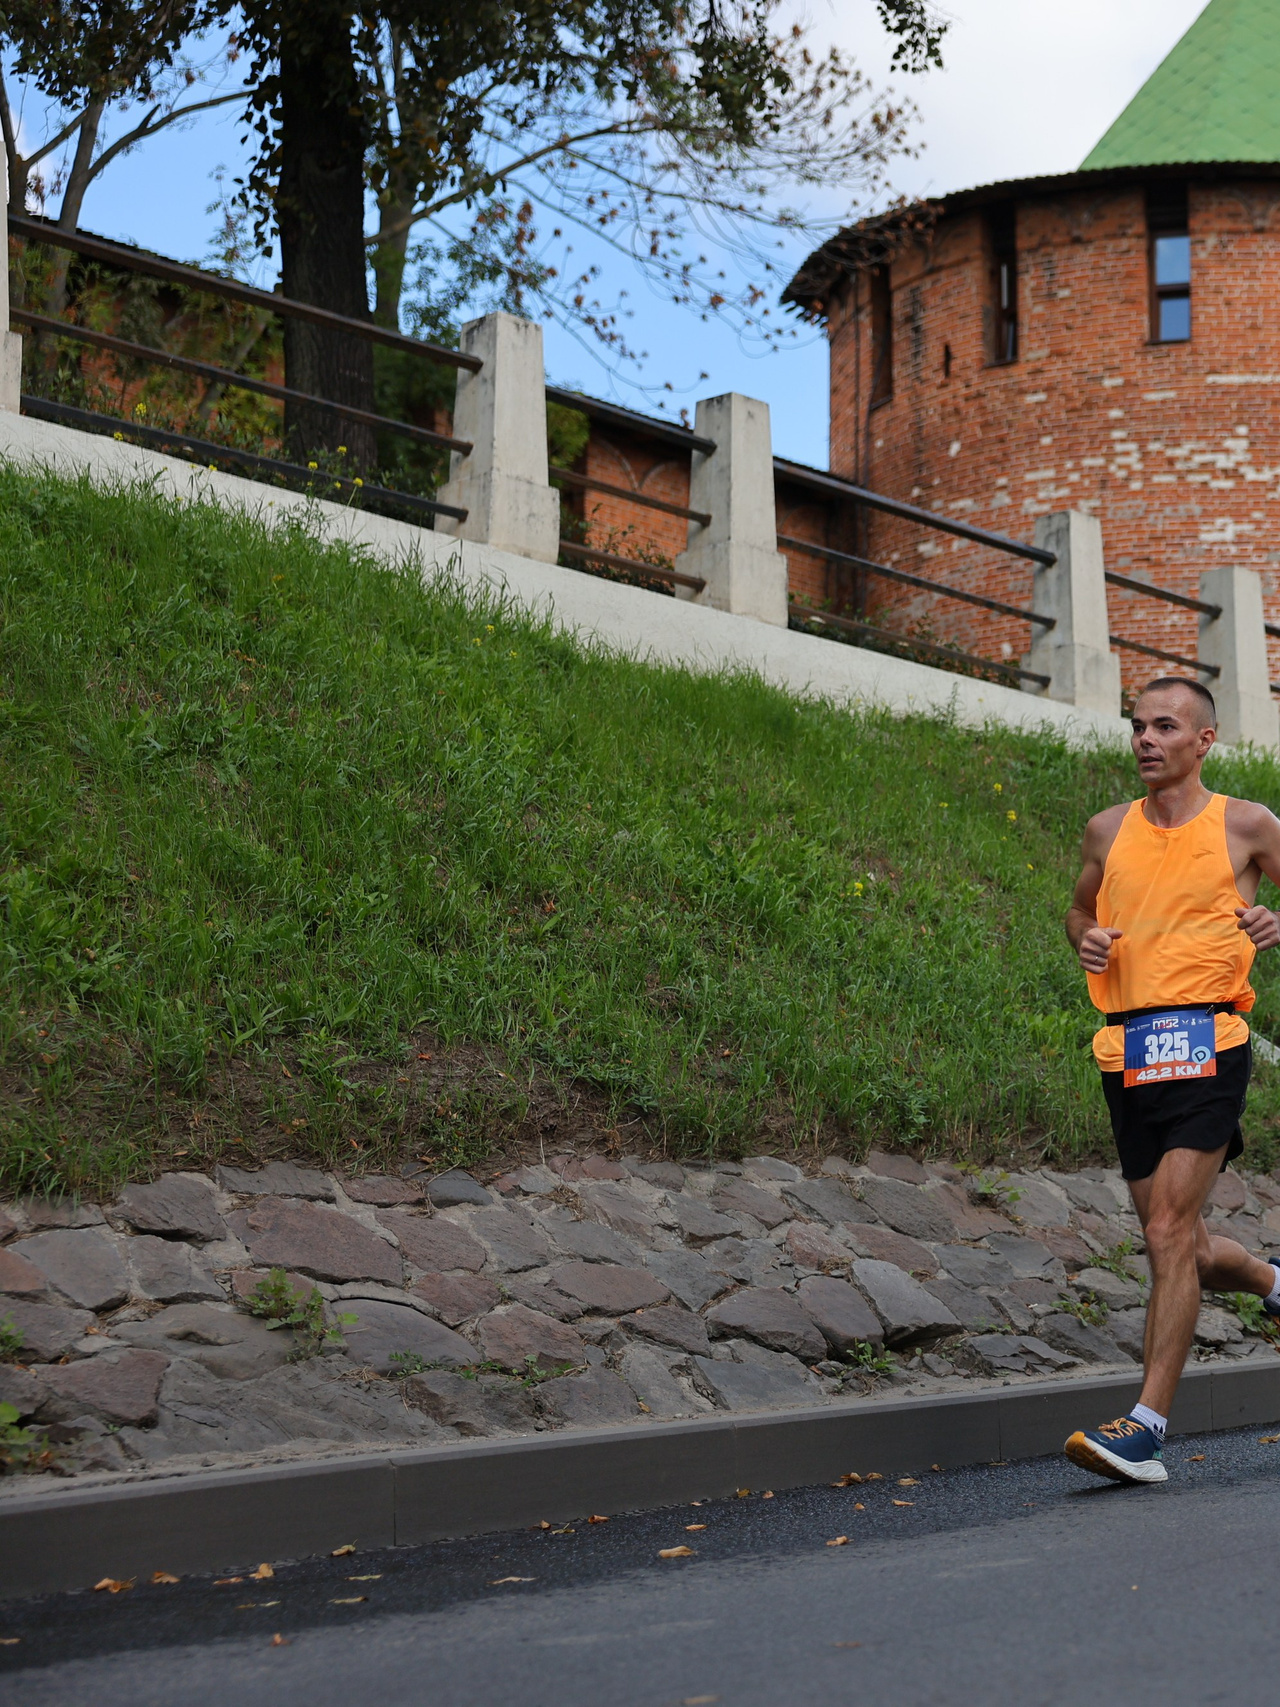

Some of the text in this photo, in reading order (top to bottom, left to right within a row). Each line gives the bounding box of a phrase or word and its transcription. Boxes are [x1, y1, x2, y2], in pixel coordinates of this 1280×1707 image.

[1144, 1031, 1190, 1065] 325
[1136, 1064, 1202, 1081] 42,2 KM
